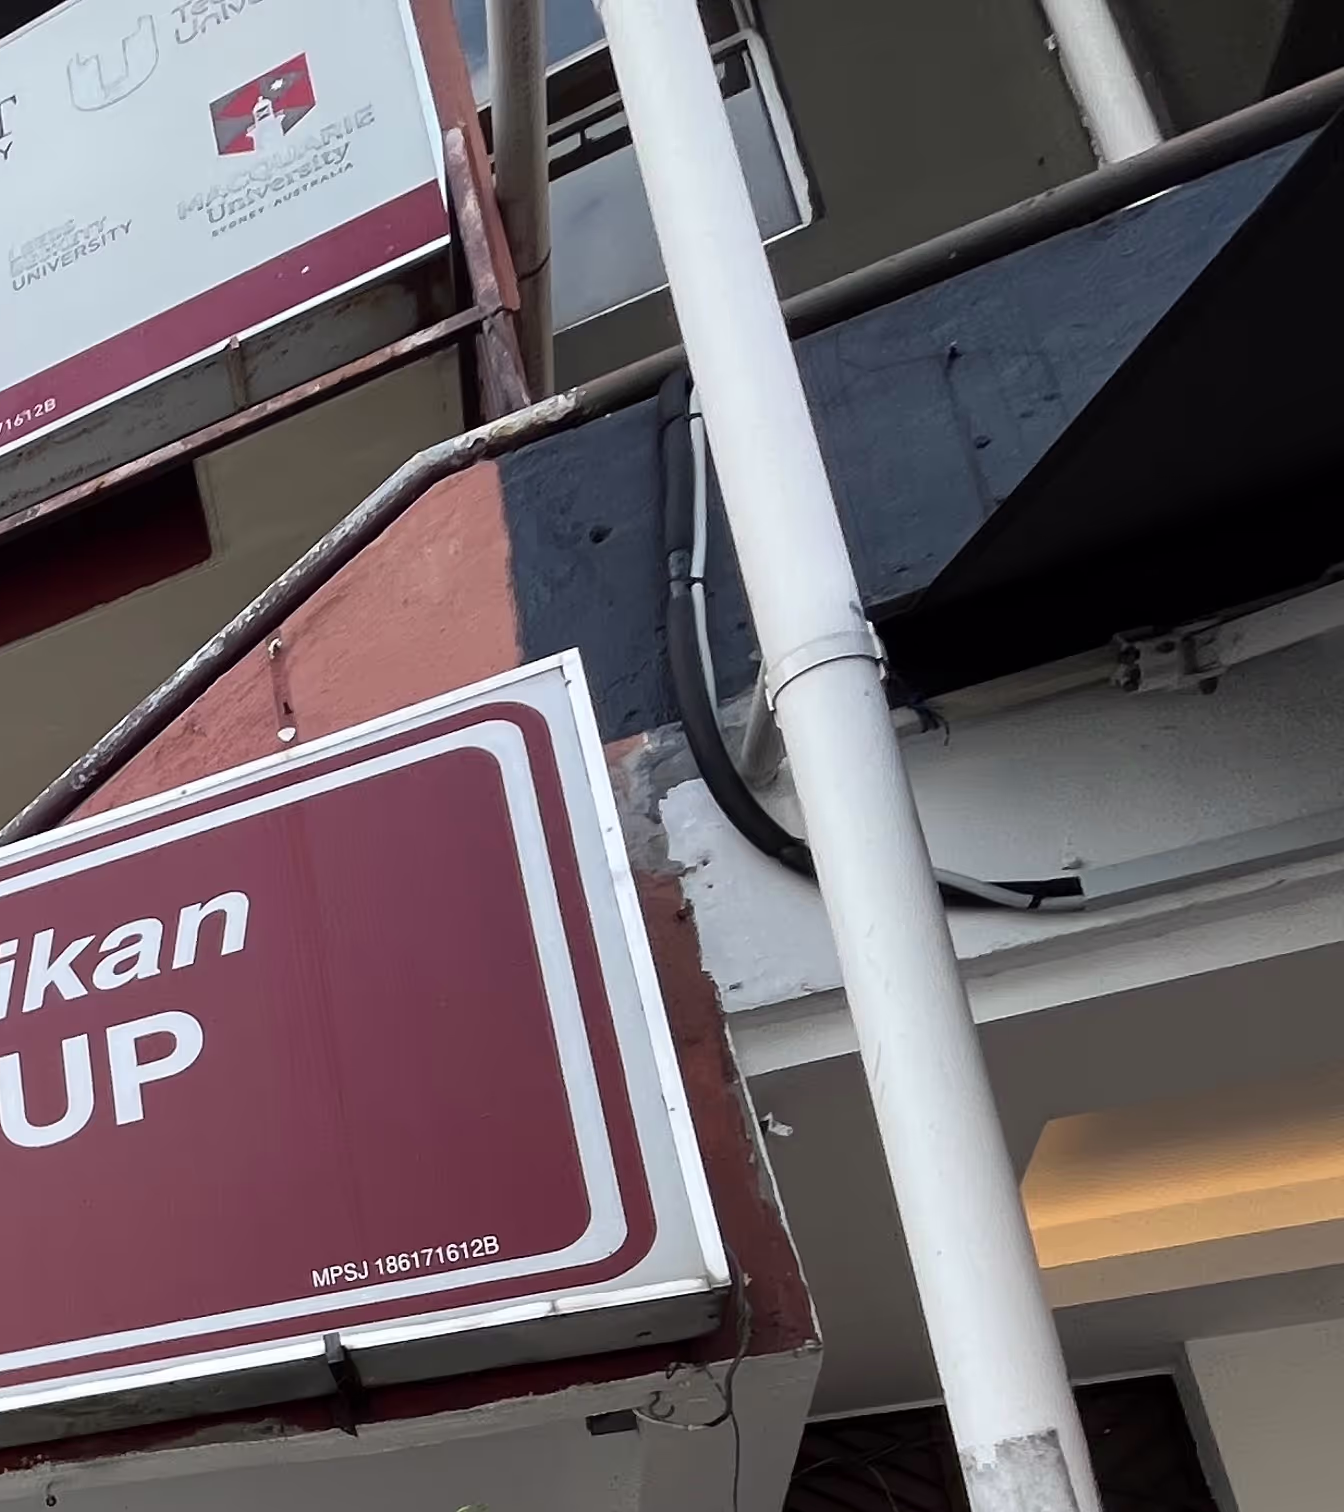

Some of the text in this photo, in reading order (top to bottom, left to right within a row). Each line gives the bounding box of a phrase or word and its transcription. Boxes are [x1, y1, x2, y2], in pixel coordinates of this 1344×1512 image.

[207, 142, 350, 224] University
[273, 162, 354, 207] AUSTRALIA
[12, 219, 133, 292] UNIVERSITY
[311, 1235, 501, 1288] MPSJ 186171612B
